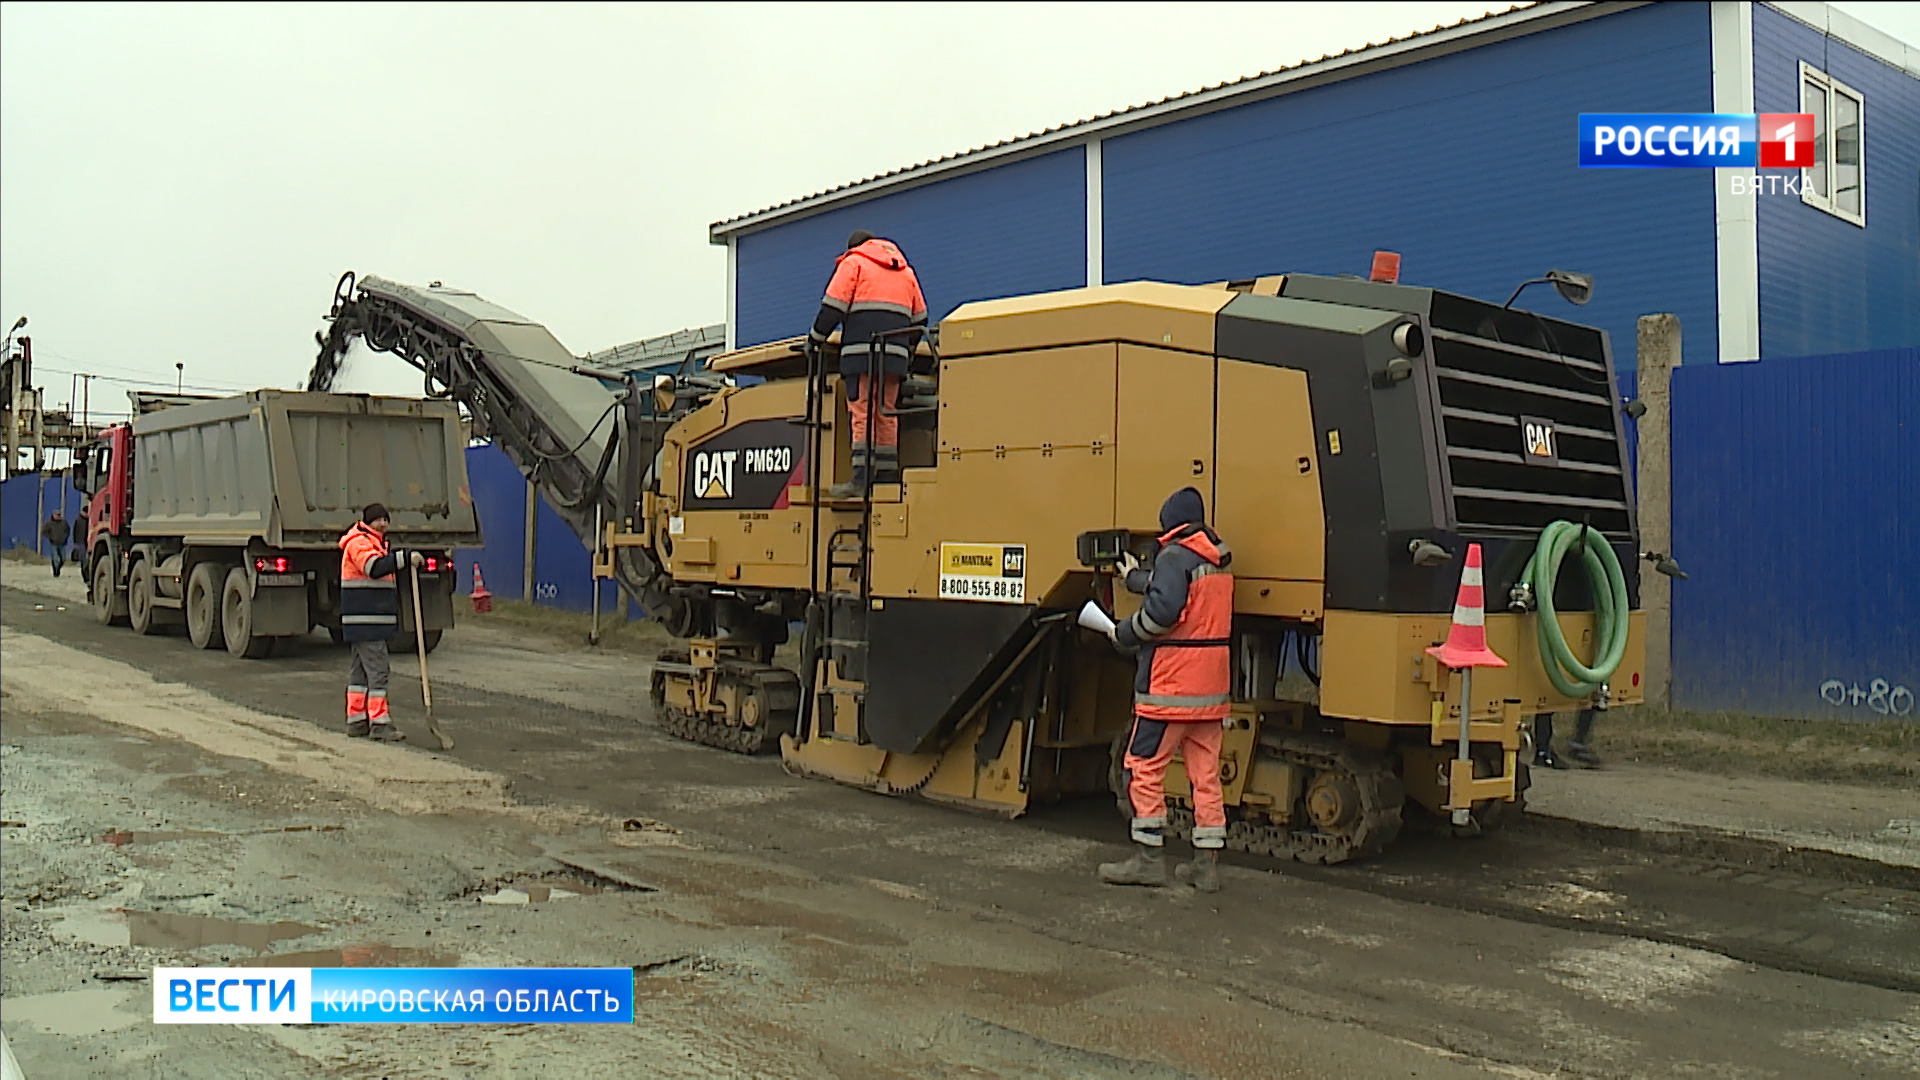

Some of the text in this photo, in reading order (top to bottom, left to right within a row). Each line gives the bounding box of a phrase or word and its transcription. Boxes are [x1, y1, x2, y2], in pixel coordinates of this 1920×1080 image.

[1526, 423, 1552, 456] CAT
[693, 446, 791, 498] CAT PM620
[961, 555, 993, 566] MANTRAC
[1004, 552, 1023, 570] CAT
[1820, 677, 1914, 715] 0+80
